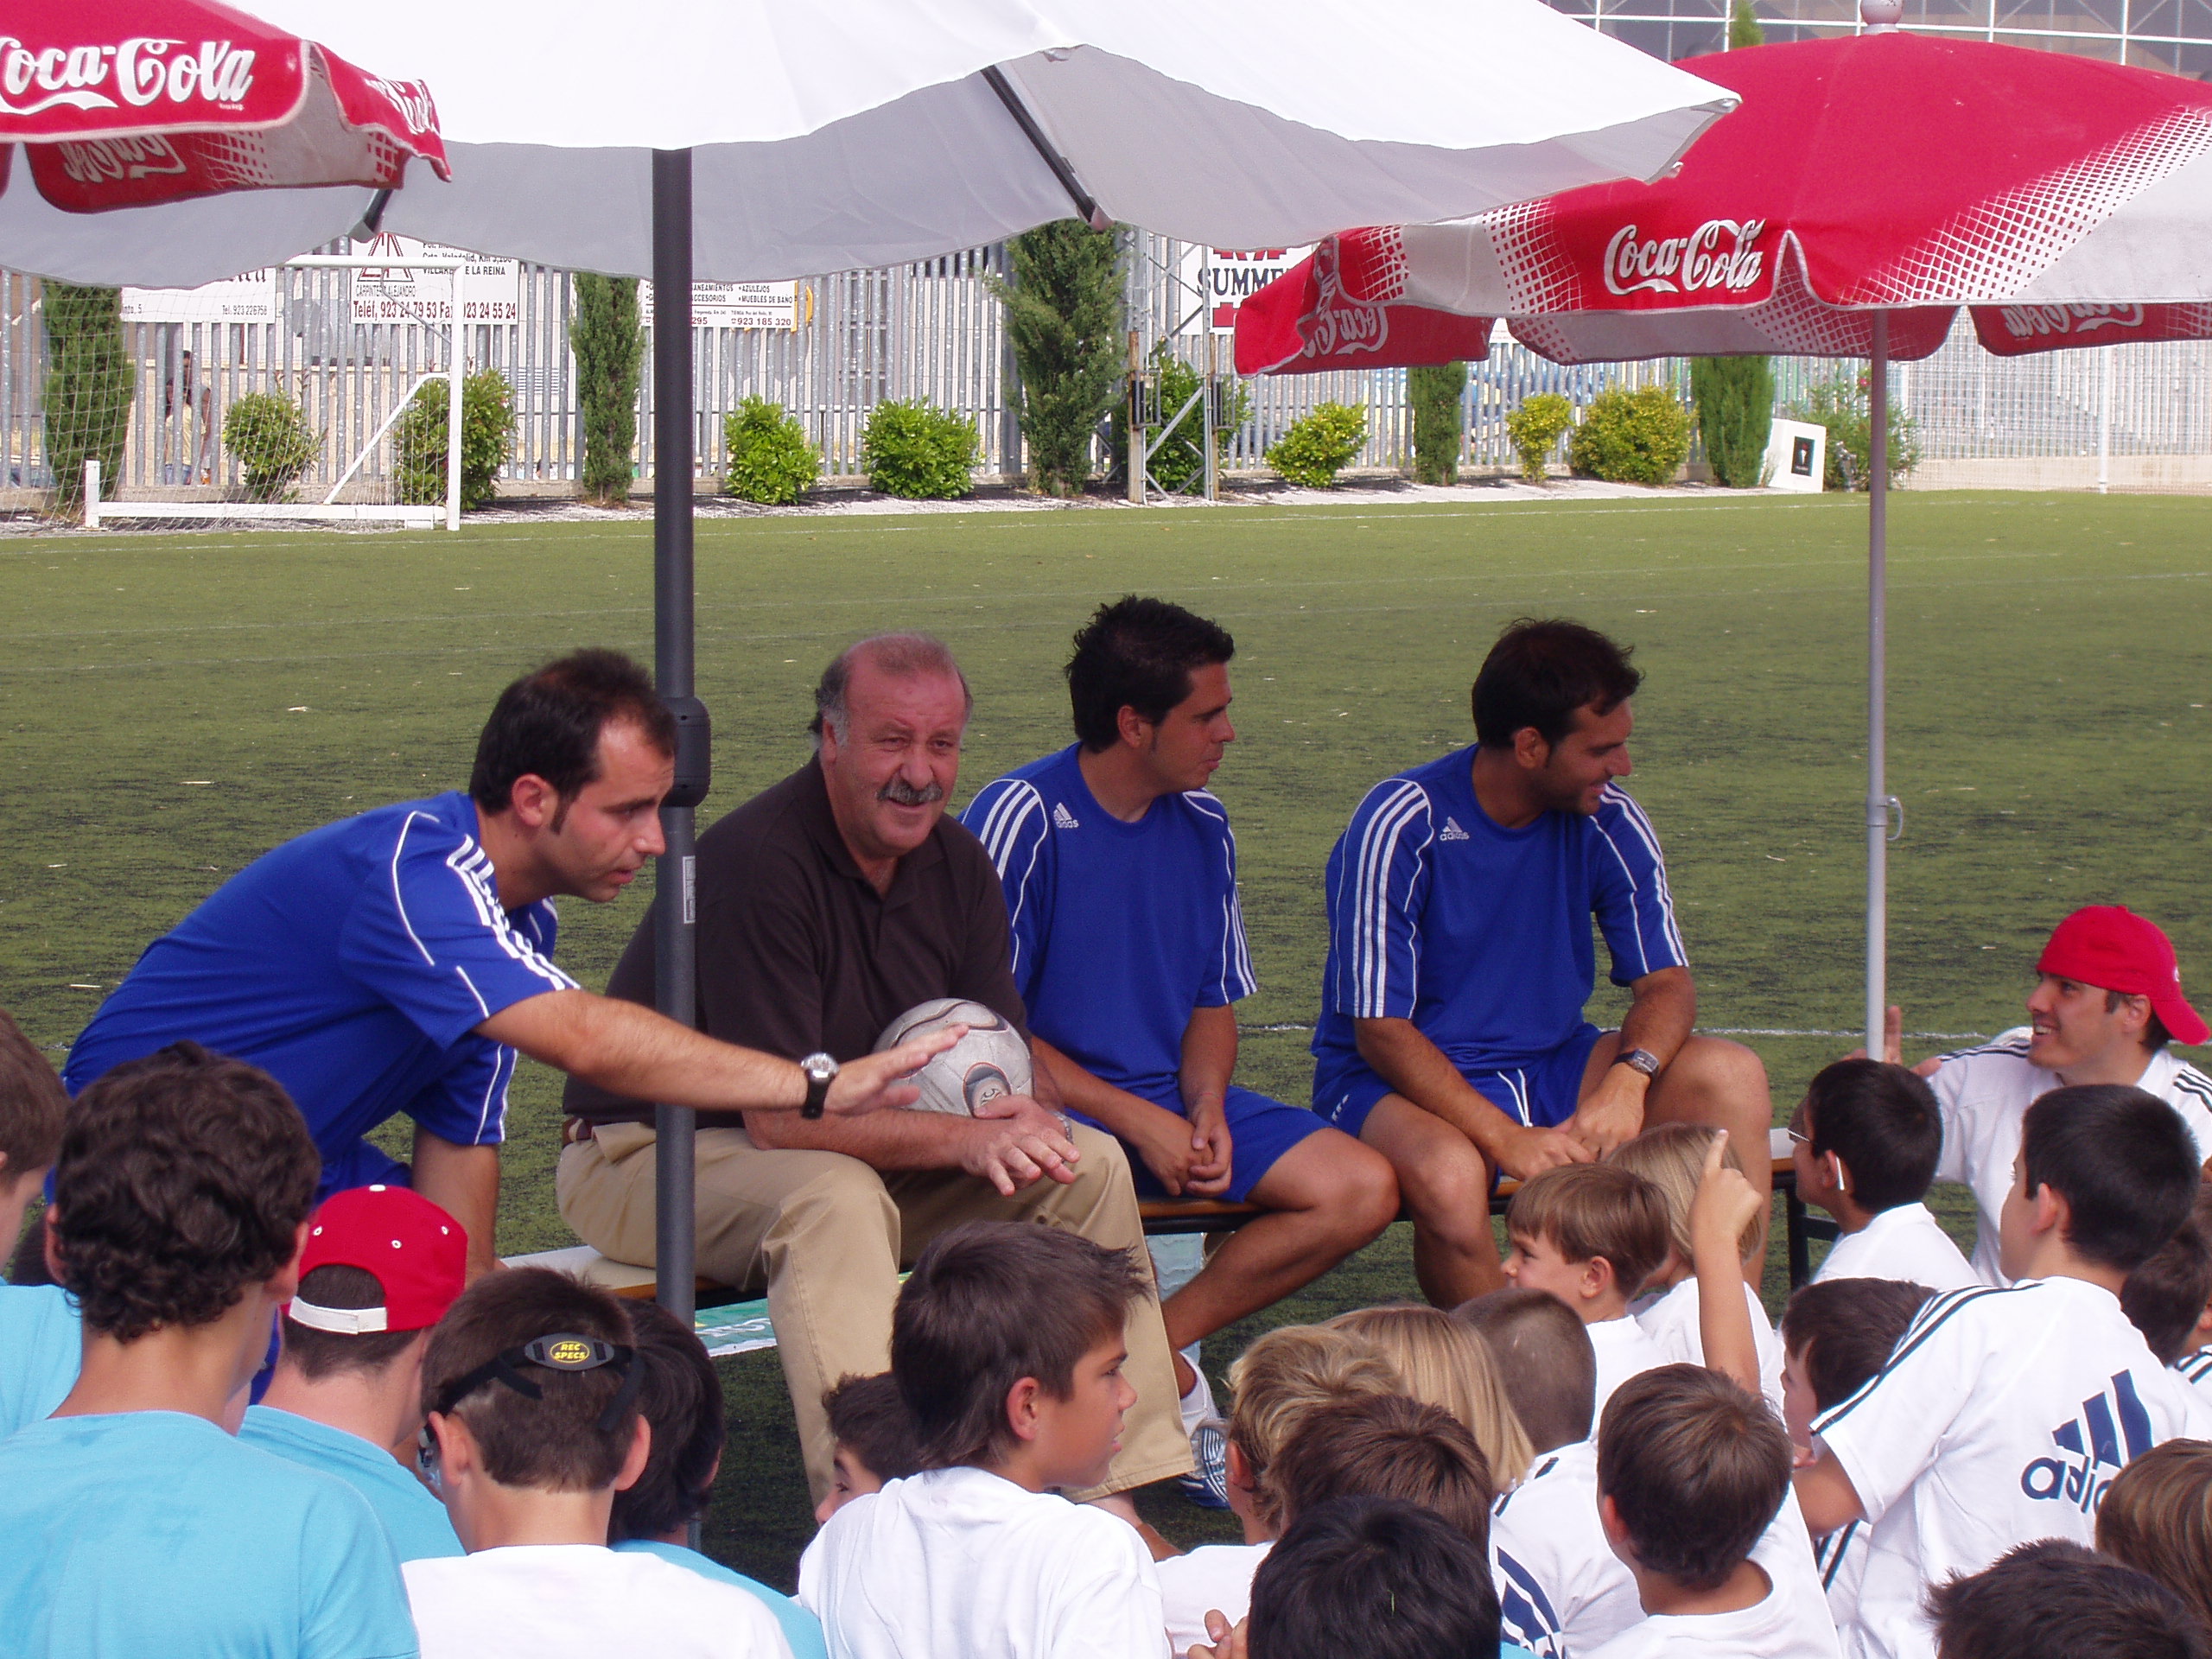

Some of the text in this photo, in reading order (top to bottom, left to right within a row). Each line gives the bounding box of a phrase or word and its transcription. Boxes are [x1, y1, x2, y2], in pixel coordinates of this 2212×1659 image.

[1604, 219, 1767, 295] Coca-Cola
[472, 266, 480, 275] LA
[483, 266, 505, 275] REINA
[692, 283, 734, 292] ANEAMIENTOS
[380, 301, 397, 318] 923
[413, 302, 423, 319] 79
[426, 302, 436, 319] 53
[463, 302, 476, 319] 23
[480, 302, 490, 319] 24
[493, 302, 503, 319] 55
[505, 302, 516, 320] 24
[737, 317, 791, 327] 923 185 320
[554, 1351, 586, 1360] SPECS
